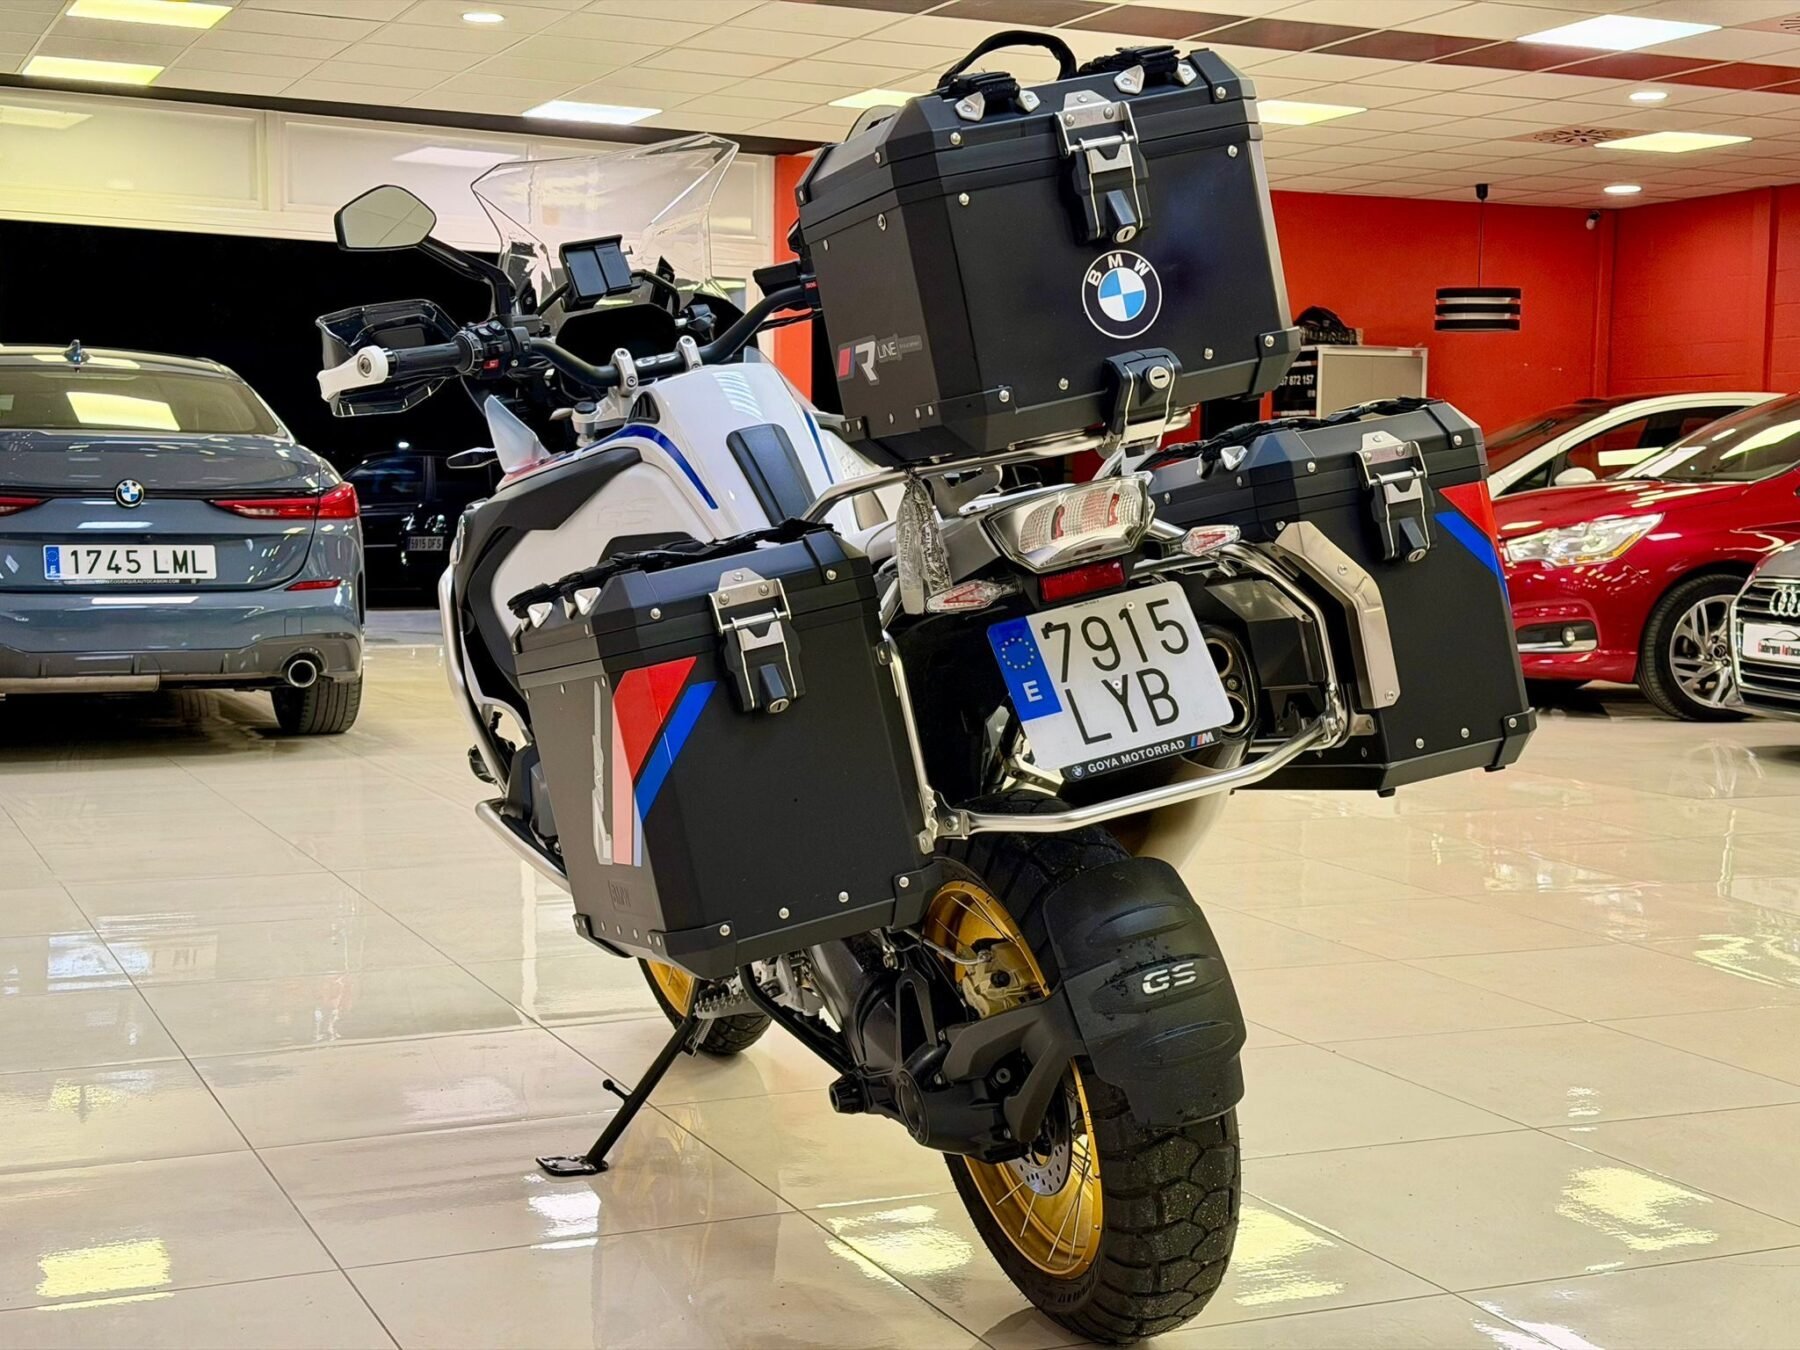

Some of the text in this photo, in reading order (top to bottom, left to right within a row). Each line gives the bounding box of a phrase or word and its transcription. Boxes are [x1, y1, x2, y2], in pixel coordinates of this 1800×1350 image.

[1087, 253, 1150, 287] BMW
[877, 341, 897, 359] LINE
[1289, 375, 1301, 386] 872
[1302, 374, 1315, 385] 157
[70, 550, 208, 574] 1745 LML
[1041, 598, 1189, 683] 7915
[1022, 680, 1042, 702] E
[1065, 668, 1180, 745] LYB
[1088, 758, 1119, 773] GOYA
[1121, 739, 1186, 764] MOTORRAD
[1142, 962, 1197, 994] GS
